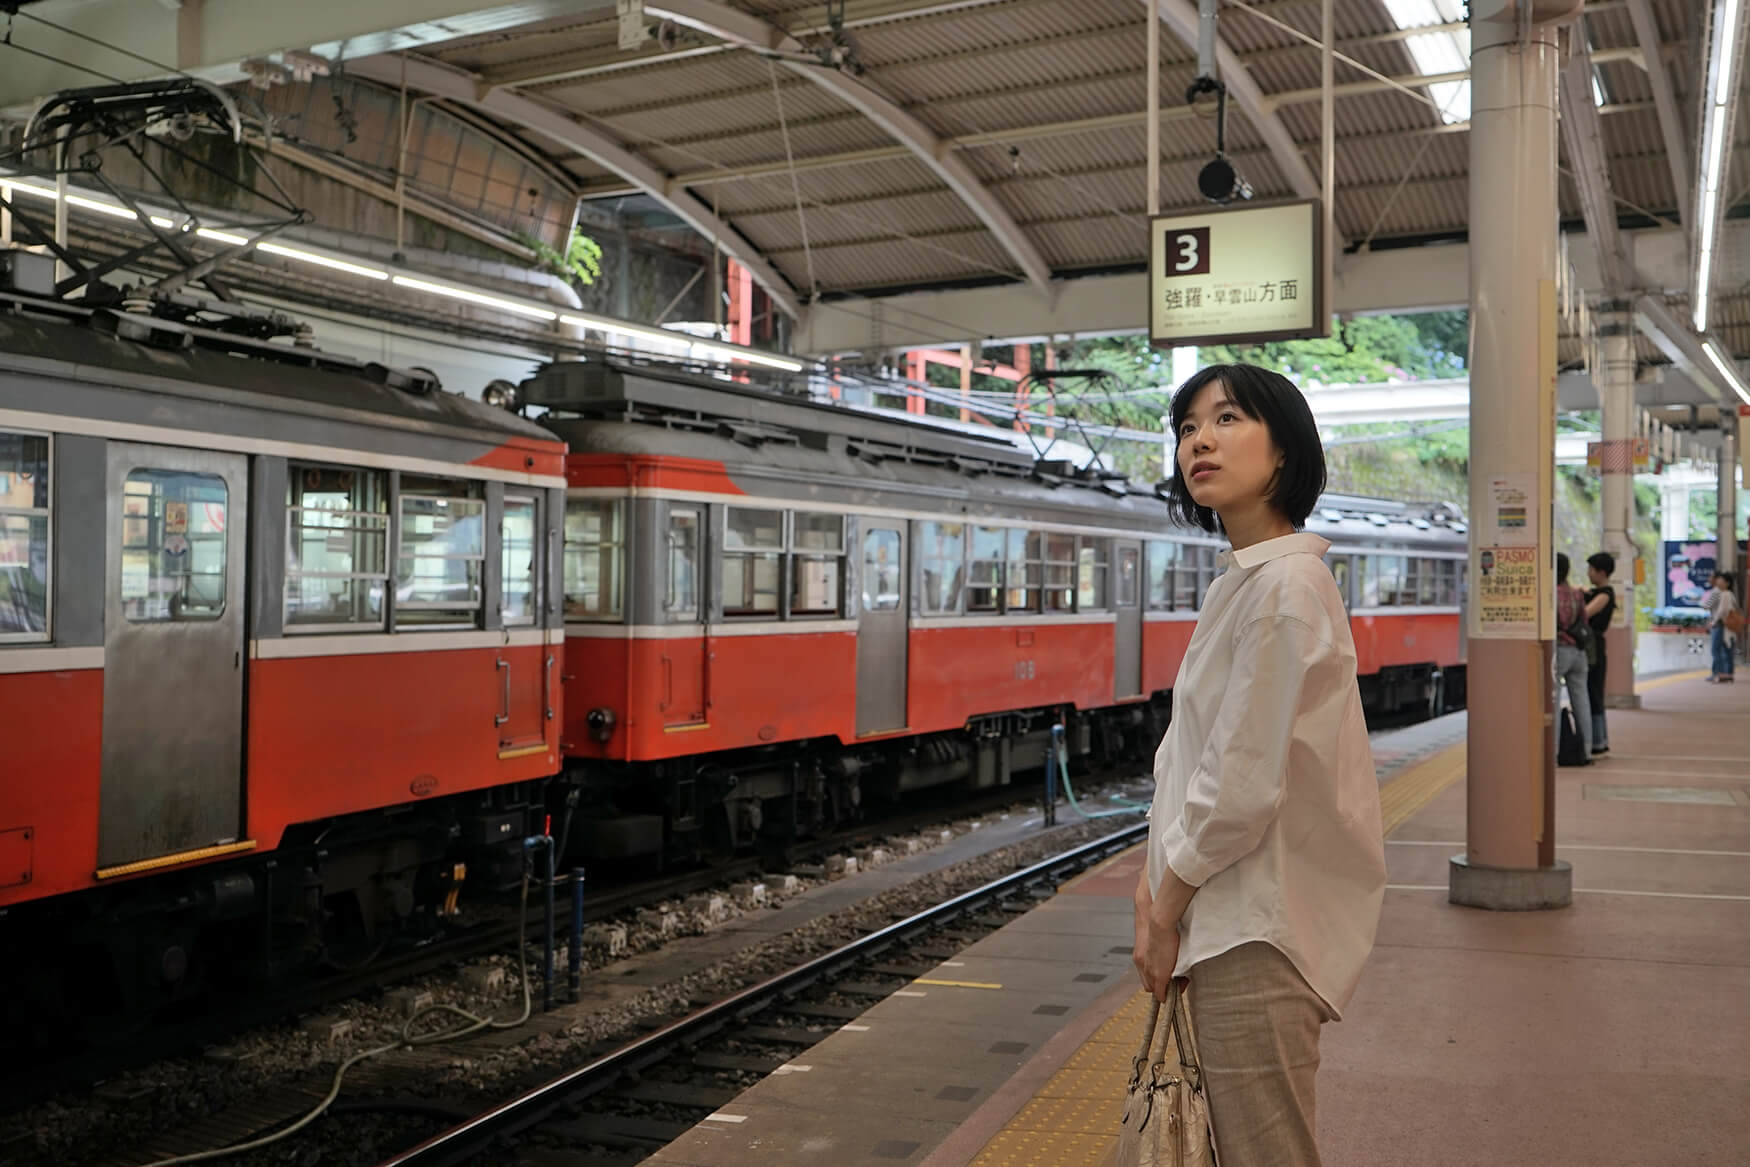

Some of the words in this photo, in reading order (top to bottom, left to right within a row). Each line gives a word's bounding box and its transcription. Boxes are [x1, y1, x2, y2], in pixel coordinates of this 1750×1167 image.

[1175, 234, 1199, 272] 3
[1165, 279, 1298, 311] 強羅・早雲山方面
[1496, 551, 1535, 564] PASMO
[1496, 563, 1533, 575] Suica
